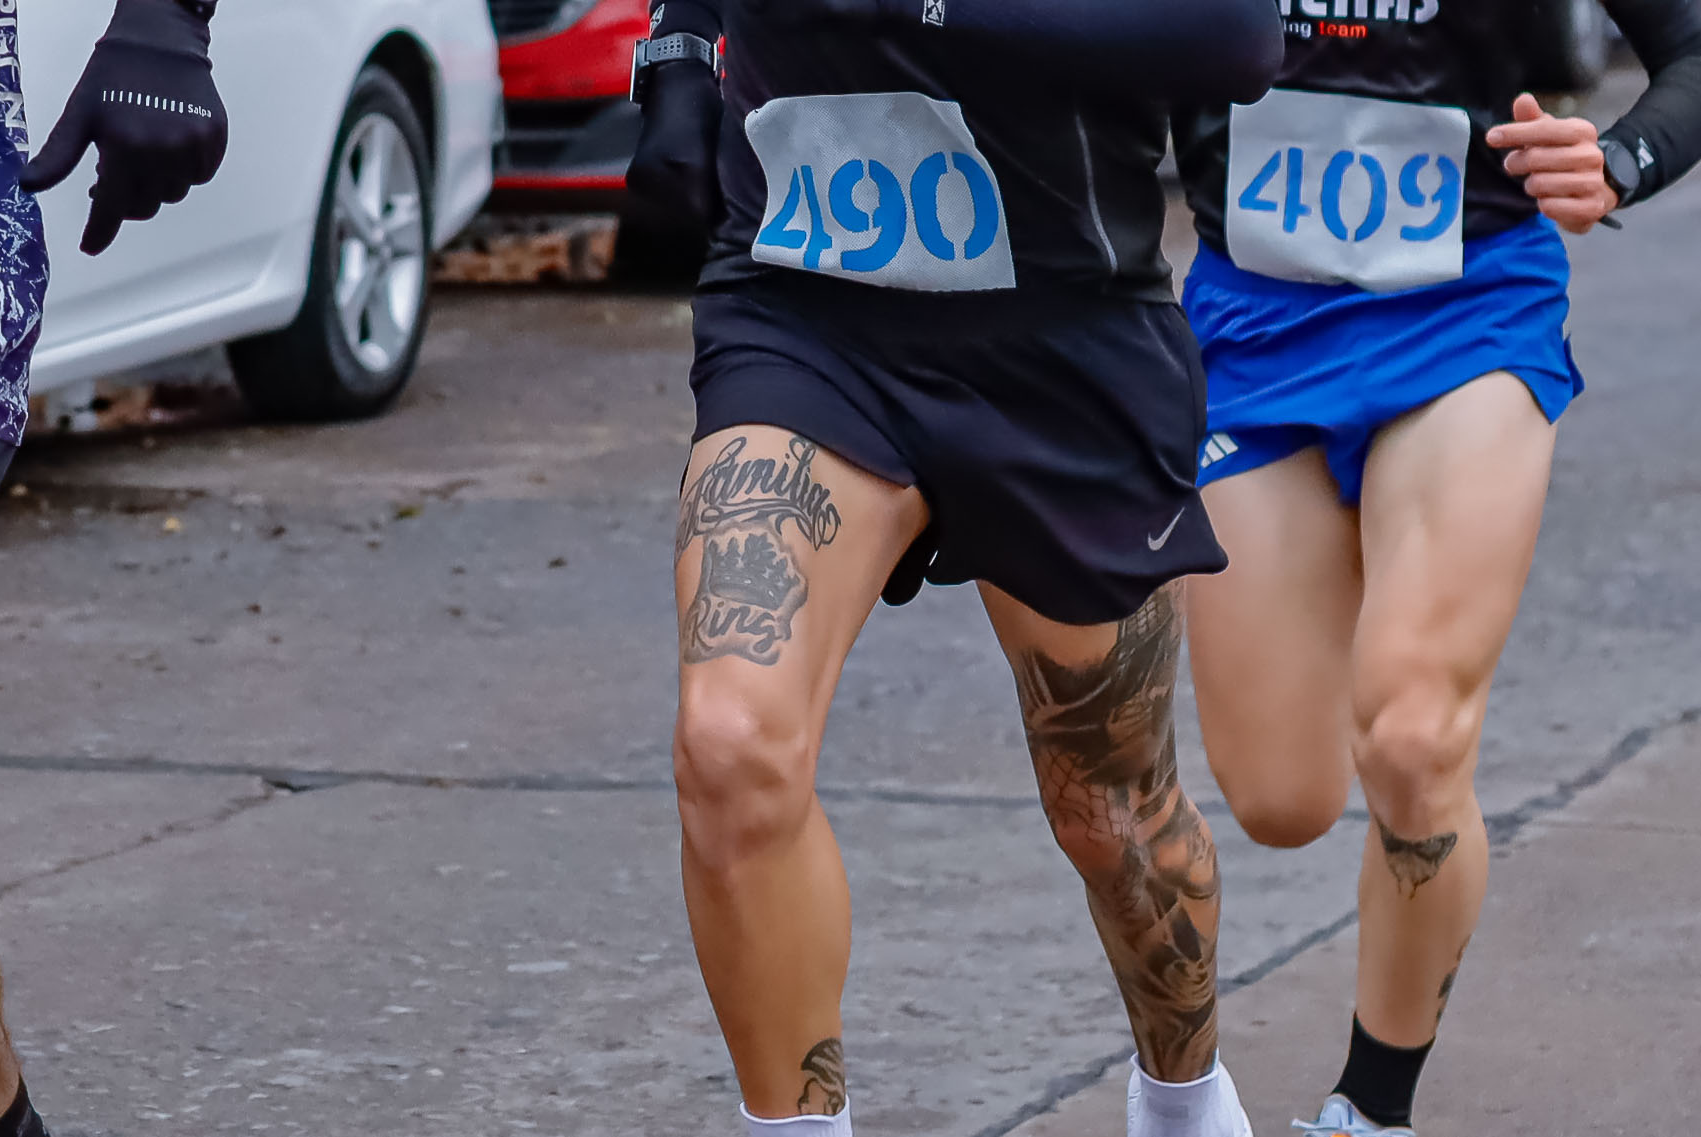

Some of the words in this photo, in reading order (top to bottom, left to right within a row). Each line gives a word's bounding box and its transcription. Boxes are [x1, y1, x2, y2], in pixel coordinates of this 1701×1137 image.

[1318, 20, 1368, 39] team
[187, 103, 212, 118] Salpa
[756, 152, 999, 272] 490
[1238, 147, 1461, 242] 409
